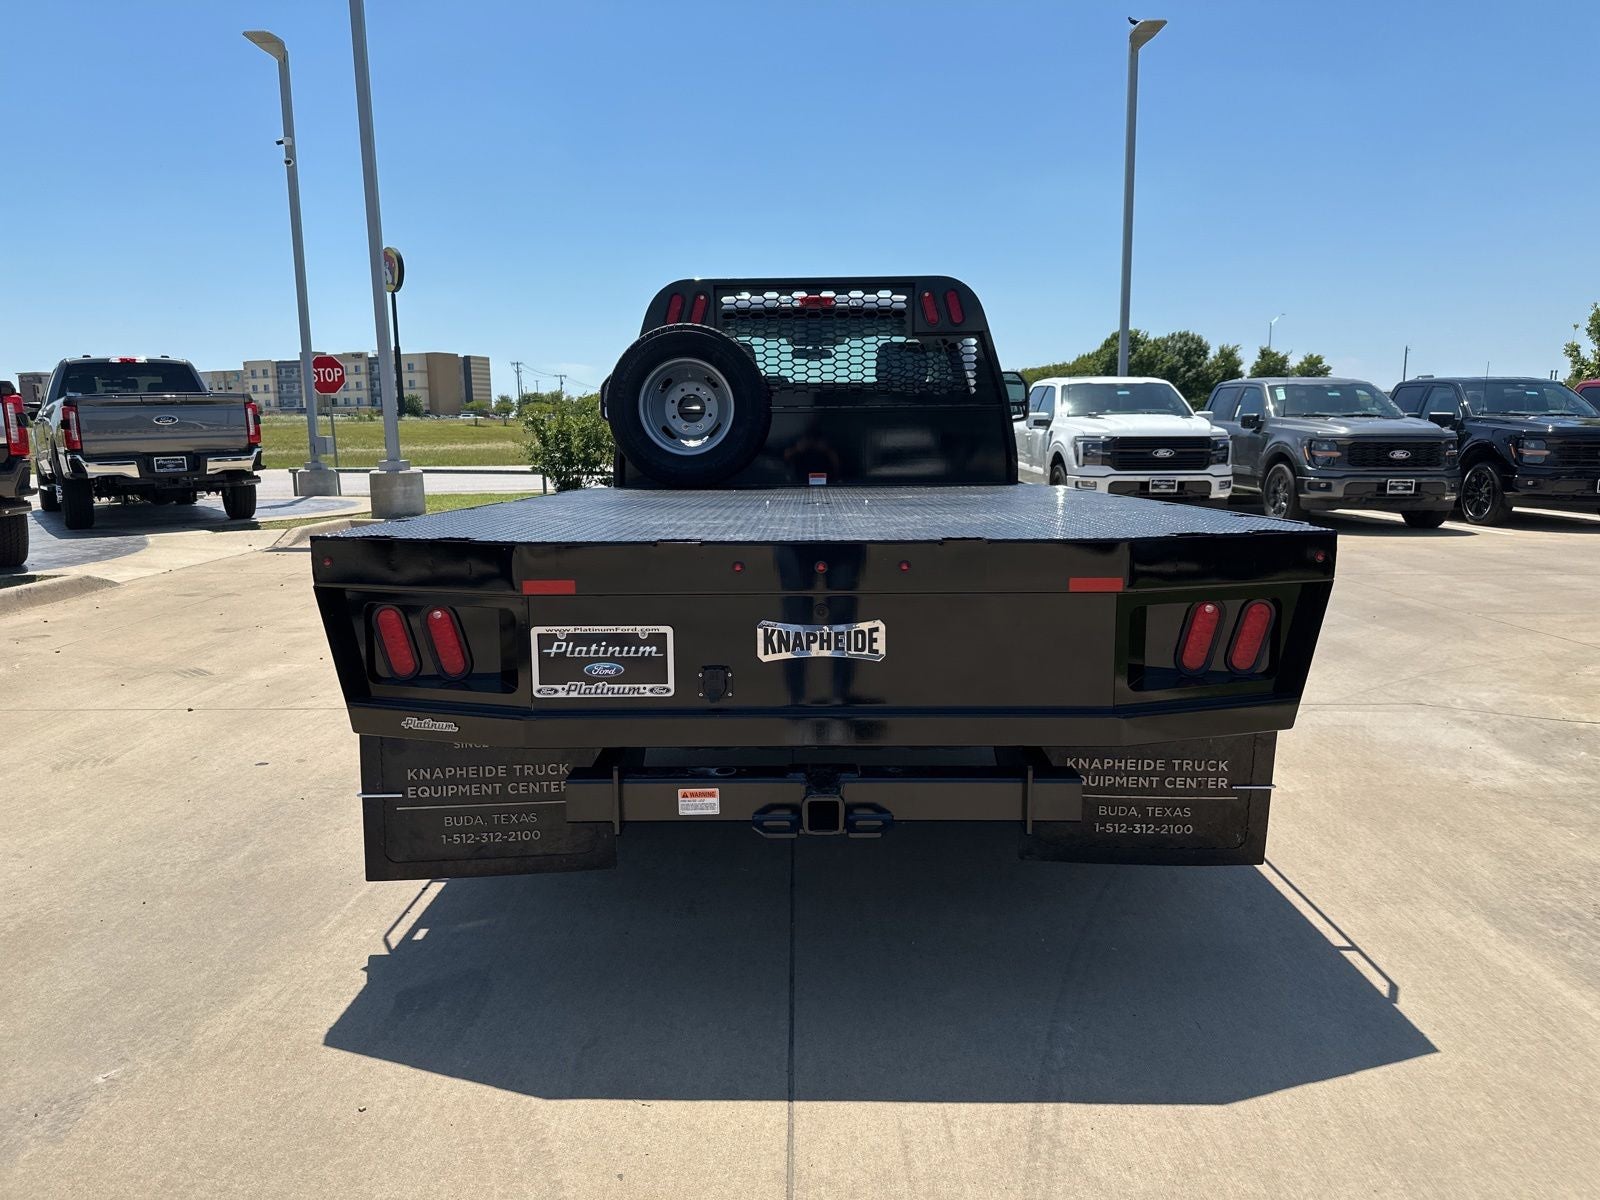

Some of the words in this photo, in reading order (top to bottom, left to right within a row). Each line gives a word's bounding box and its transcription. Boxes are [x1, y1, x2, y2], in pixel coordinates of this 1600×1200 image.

[313, 367, 343, 383] STOP
[763, 626, 880, 656] KNAPHEIDE
[542, 640, 665, 658] Platinum
[565, 682, 647, 696] Platinum
[401, 716, 459, 732] Platinum
[407, 765, 507, 781] KNAPHEIDE
[513, 763, 569, 777] TRUCK
[1066, 757, 1165, 772] KNAPHEIDE
[1172, 760, 1229, 772] TRUCK
[1164, 776, 1228, 789] CENTER
[407, 783, 502, 799] EQUIPMENT
[1098, 805, 1142, 818] BUDA,
[1145, 806, 1192, 818] TEXAS
[444, 815, 488, 827] BUDA,
[492, 812, 538, 825] TEXAS
[1093, 822, 1194, 835] 1-512-312-2100
[440, 830, 541, 845] 1-512-312-2100
